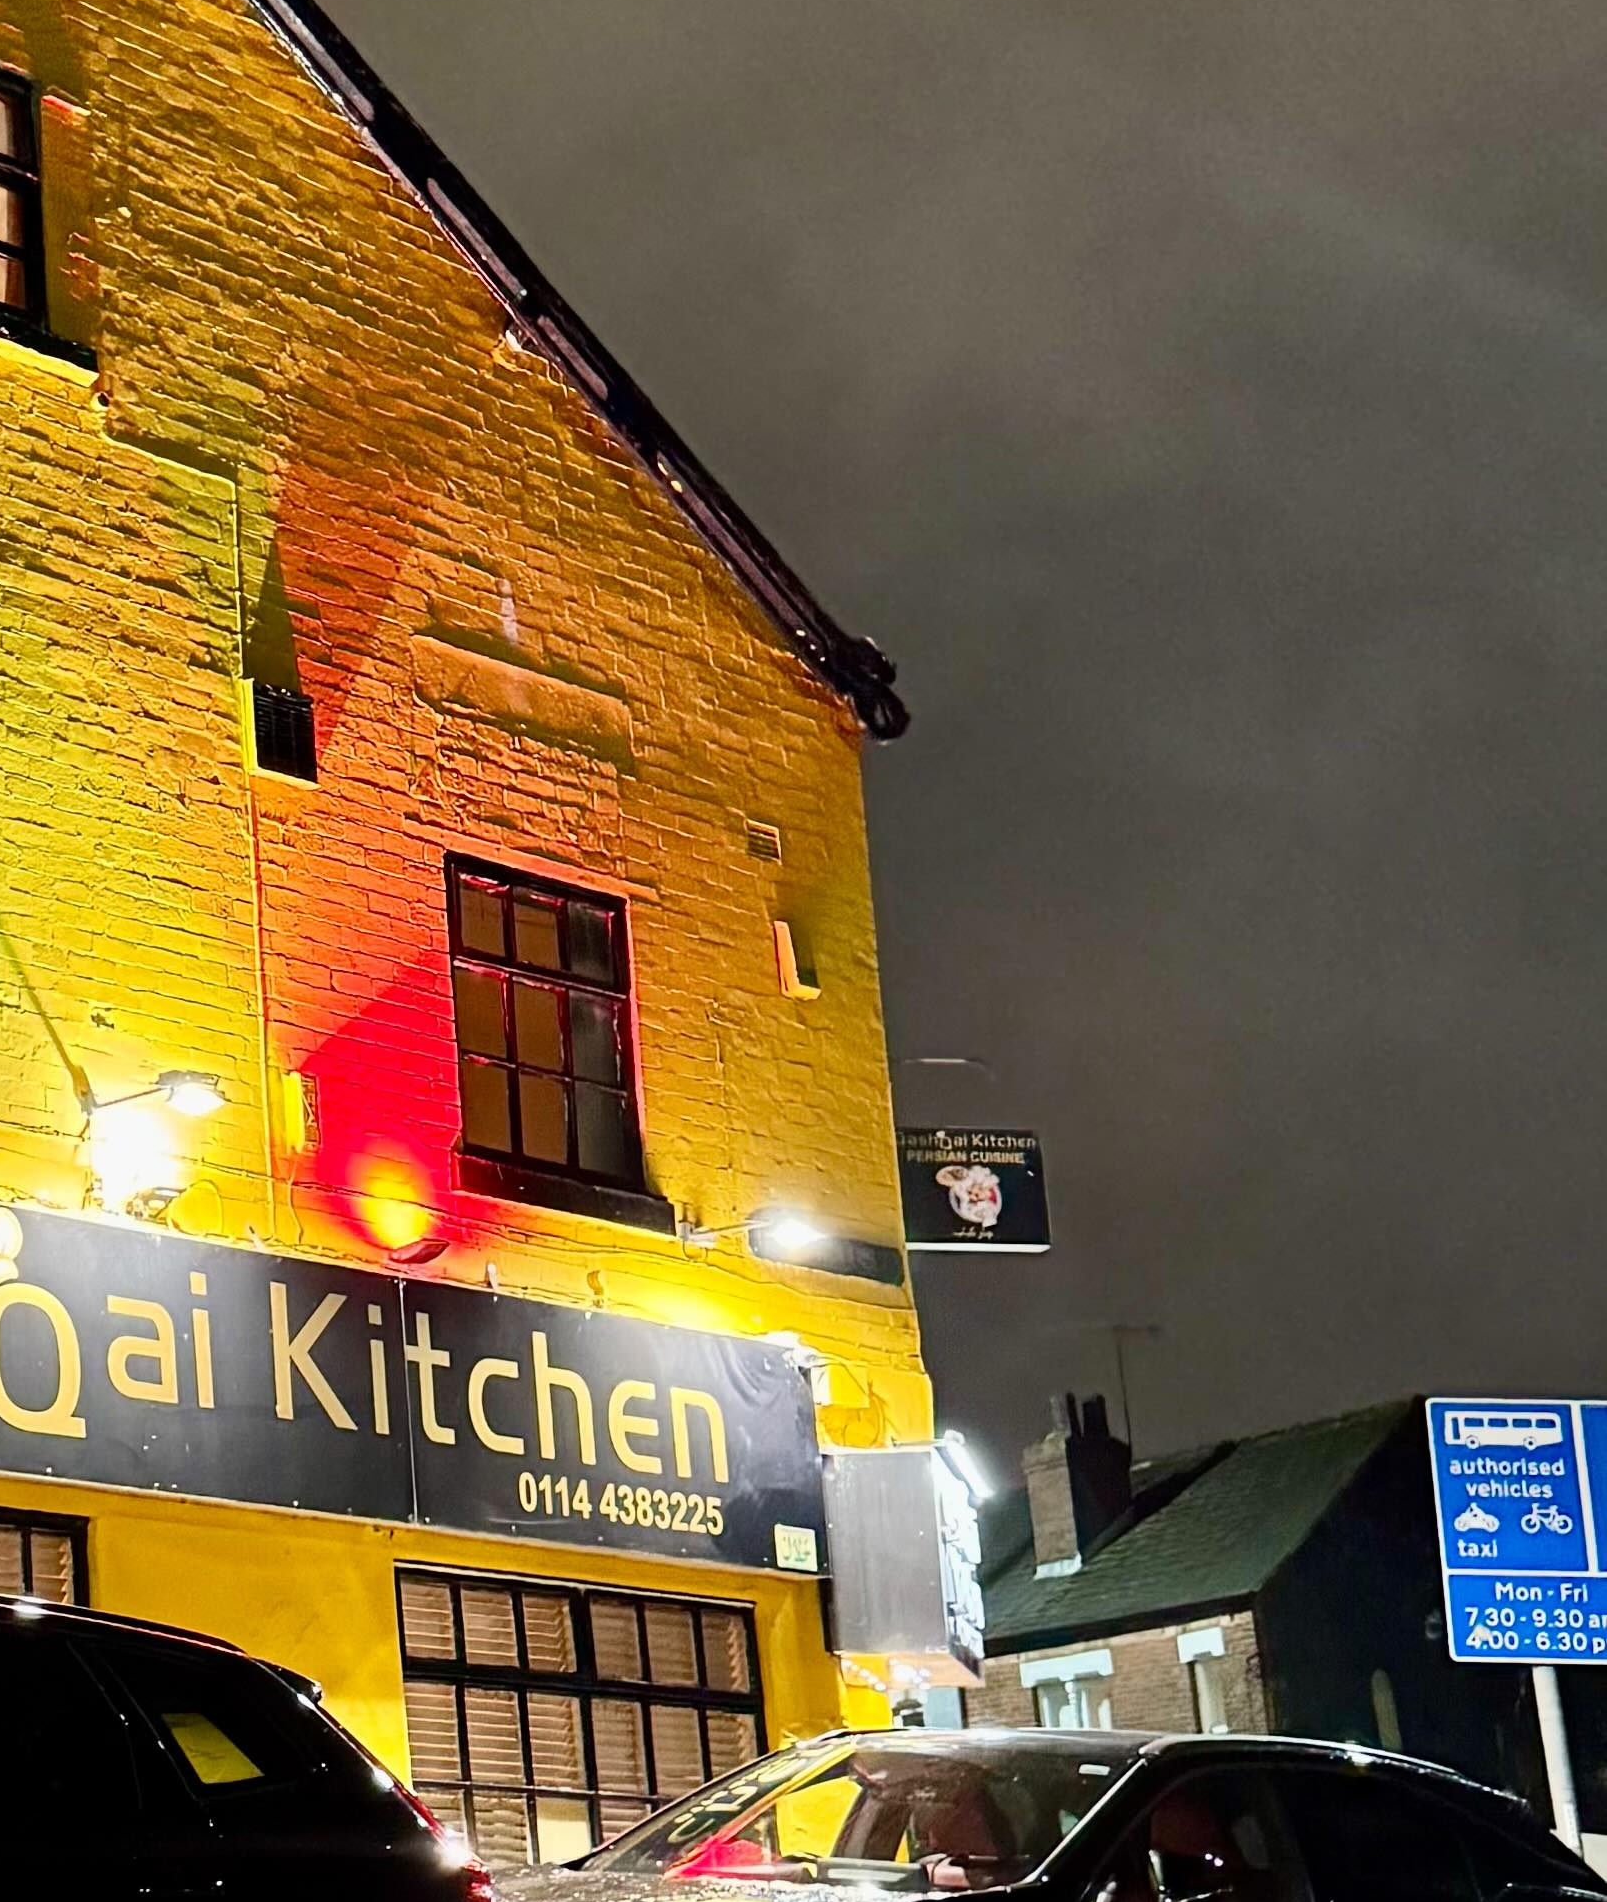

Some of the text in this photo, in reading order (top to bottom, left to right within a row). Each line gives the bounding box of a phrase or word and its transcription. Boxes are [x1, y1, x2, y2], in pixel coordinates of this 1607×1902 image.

[906, 1150, 1026, 1164] PERSIAN CUISINE
[269, 1281, 729, 1483] Kitchen
[1449, 1456, 1566, 1476] authorised
[1465, 1478, 1554, 1499] vehicles
[518, 1471, 724, 1537] 0114 4383225
[1457, 1538, 1499, 1558] taxi
[1494, 1581, 1542, 1602] Mon
[1559, 1582, 1589, 1603] Fri
[1464, 1607, 1516, 1628] 730
[1531, 1608, 1584, 1629] 9.30
[1535, 1631, 1588, 1652] 6.30
